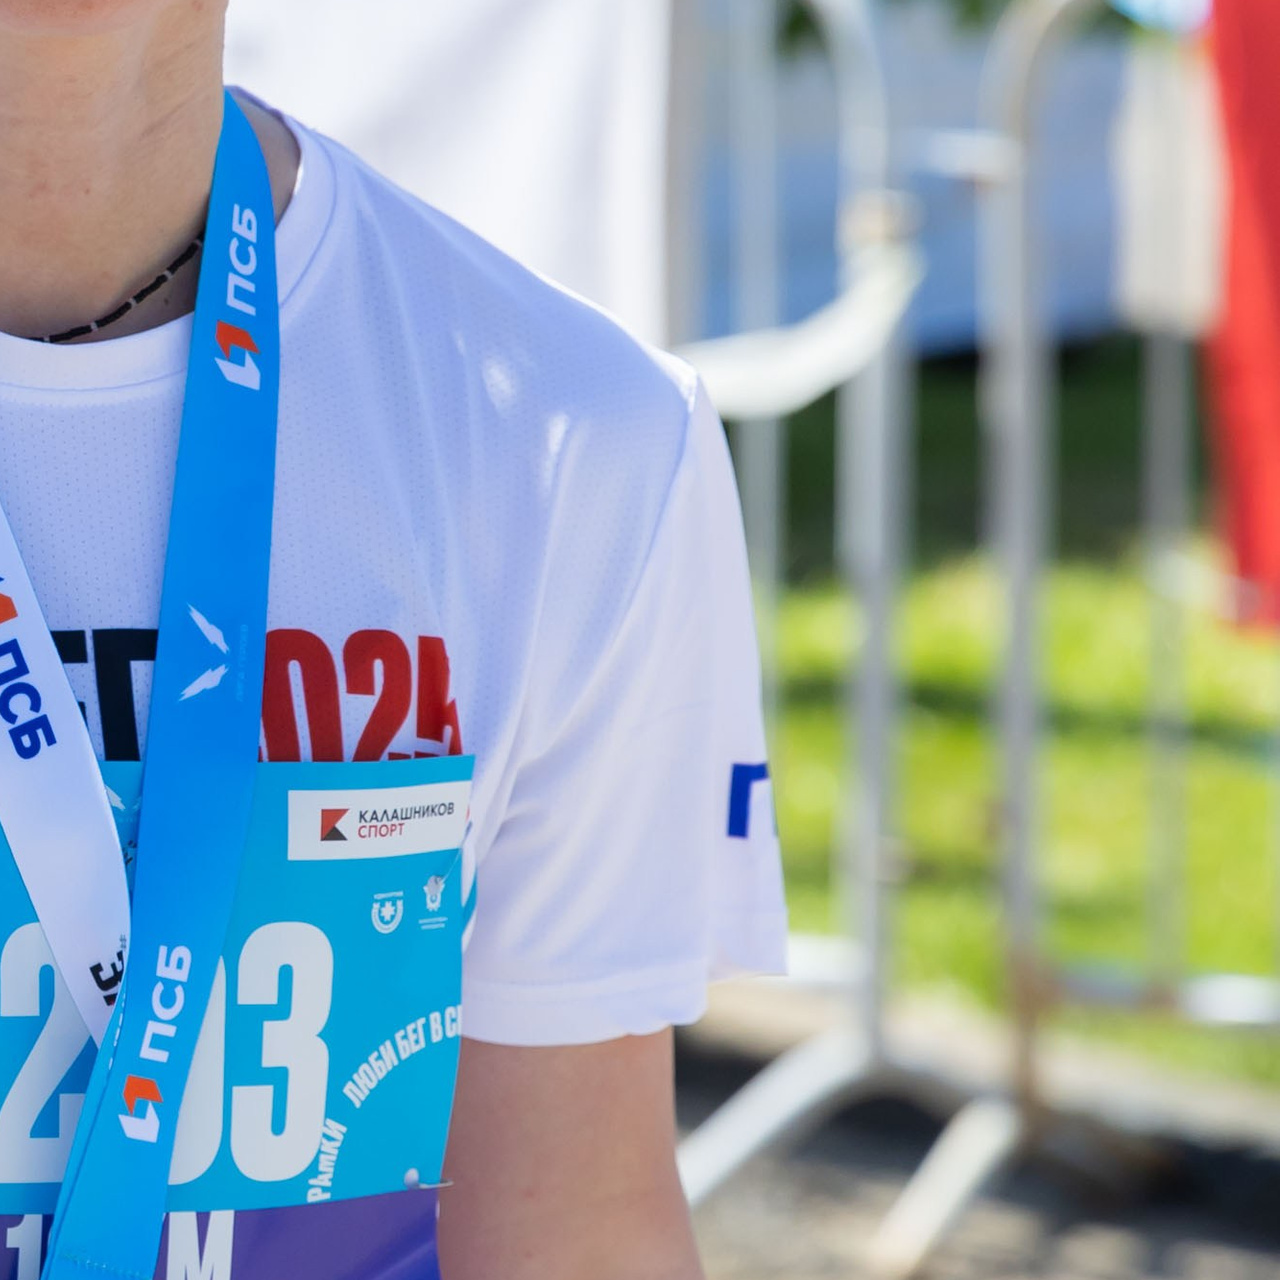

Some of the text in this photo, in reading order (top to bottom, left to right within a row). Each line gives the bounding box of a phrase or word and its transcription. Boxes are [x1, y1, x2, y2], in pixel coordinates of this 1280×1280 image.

[225, 203, 258, 316] ПСБ
[357, 823, 405, 839] СПОРТ
[358, 802, 455, 823] КАЛАШНИКОВ
[139, 944, 192, 1063] ПСБ
[342, 1039, 399, 1109] ЛЮБИ
[394, 1017, 426, 1061] БЕГ
[429, 1011, 443, 1043] В
